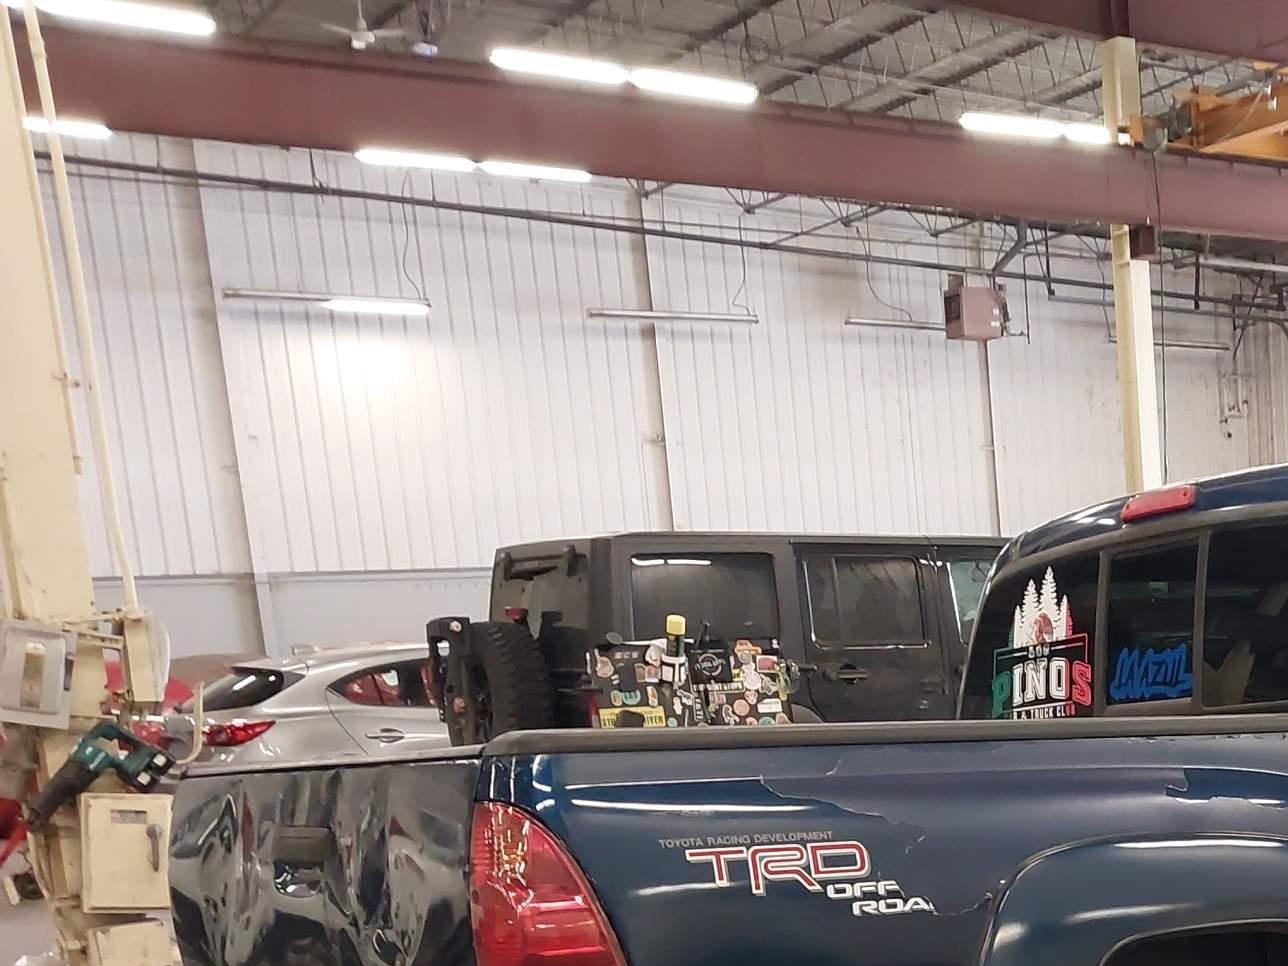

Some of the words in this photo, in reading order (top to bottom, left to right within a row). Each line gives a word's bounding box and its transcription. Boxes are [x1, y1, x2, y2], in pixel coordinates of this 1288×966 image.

[992, 656, 1092, 719] PINOS
[1030, 706, 1054, 720] TRUCK
[658, 837, 704, 849] TOYOTA
[706, 834, 750, 846] RACING
[753, 830, 833, 844] DEVELOPMENT
[685, 840, 871, 896] TRD
[826, 879, 904, 899] OFF
[852, 896, 936, 916] ROA
